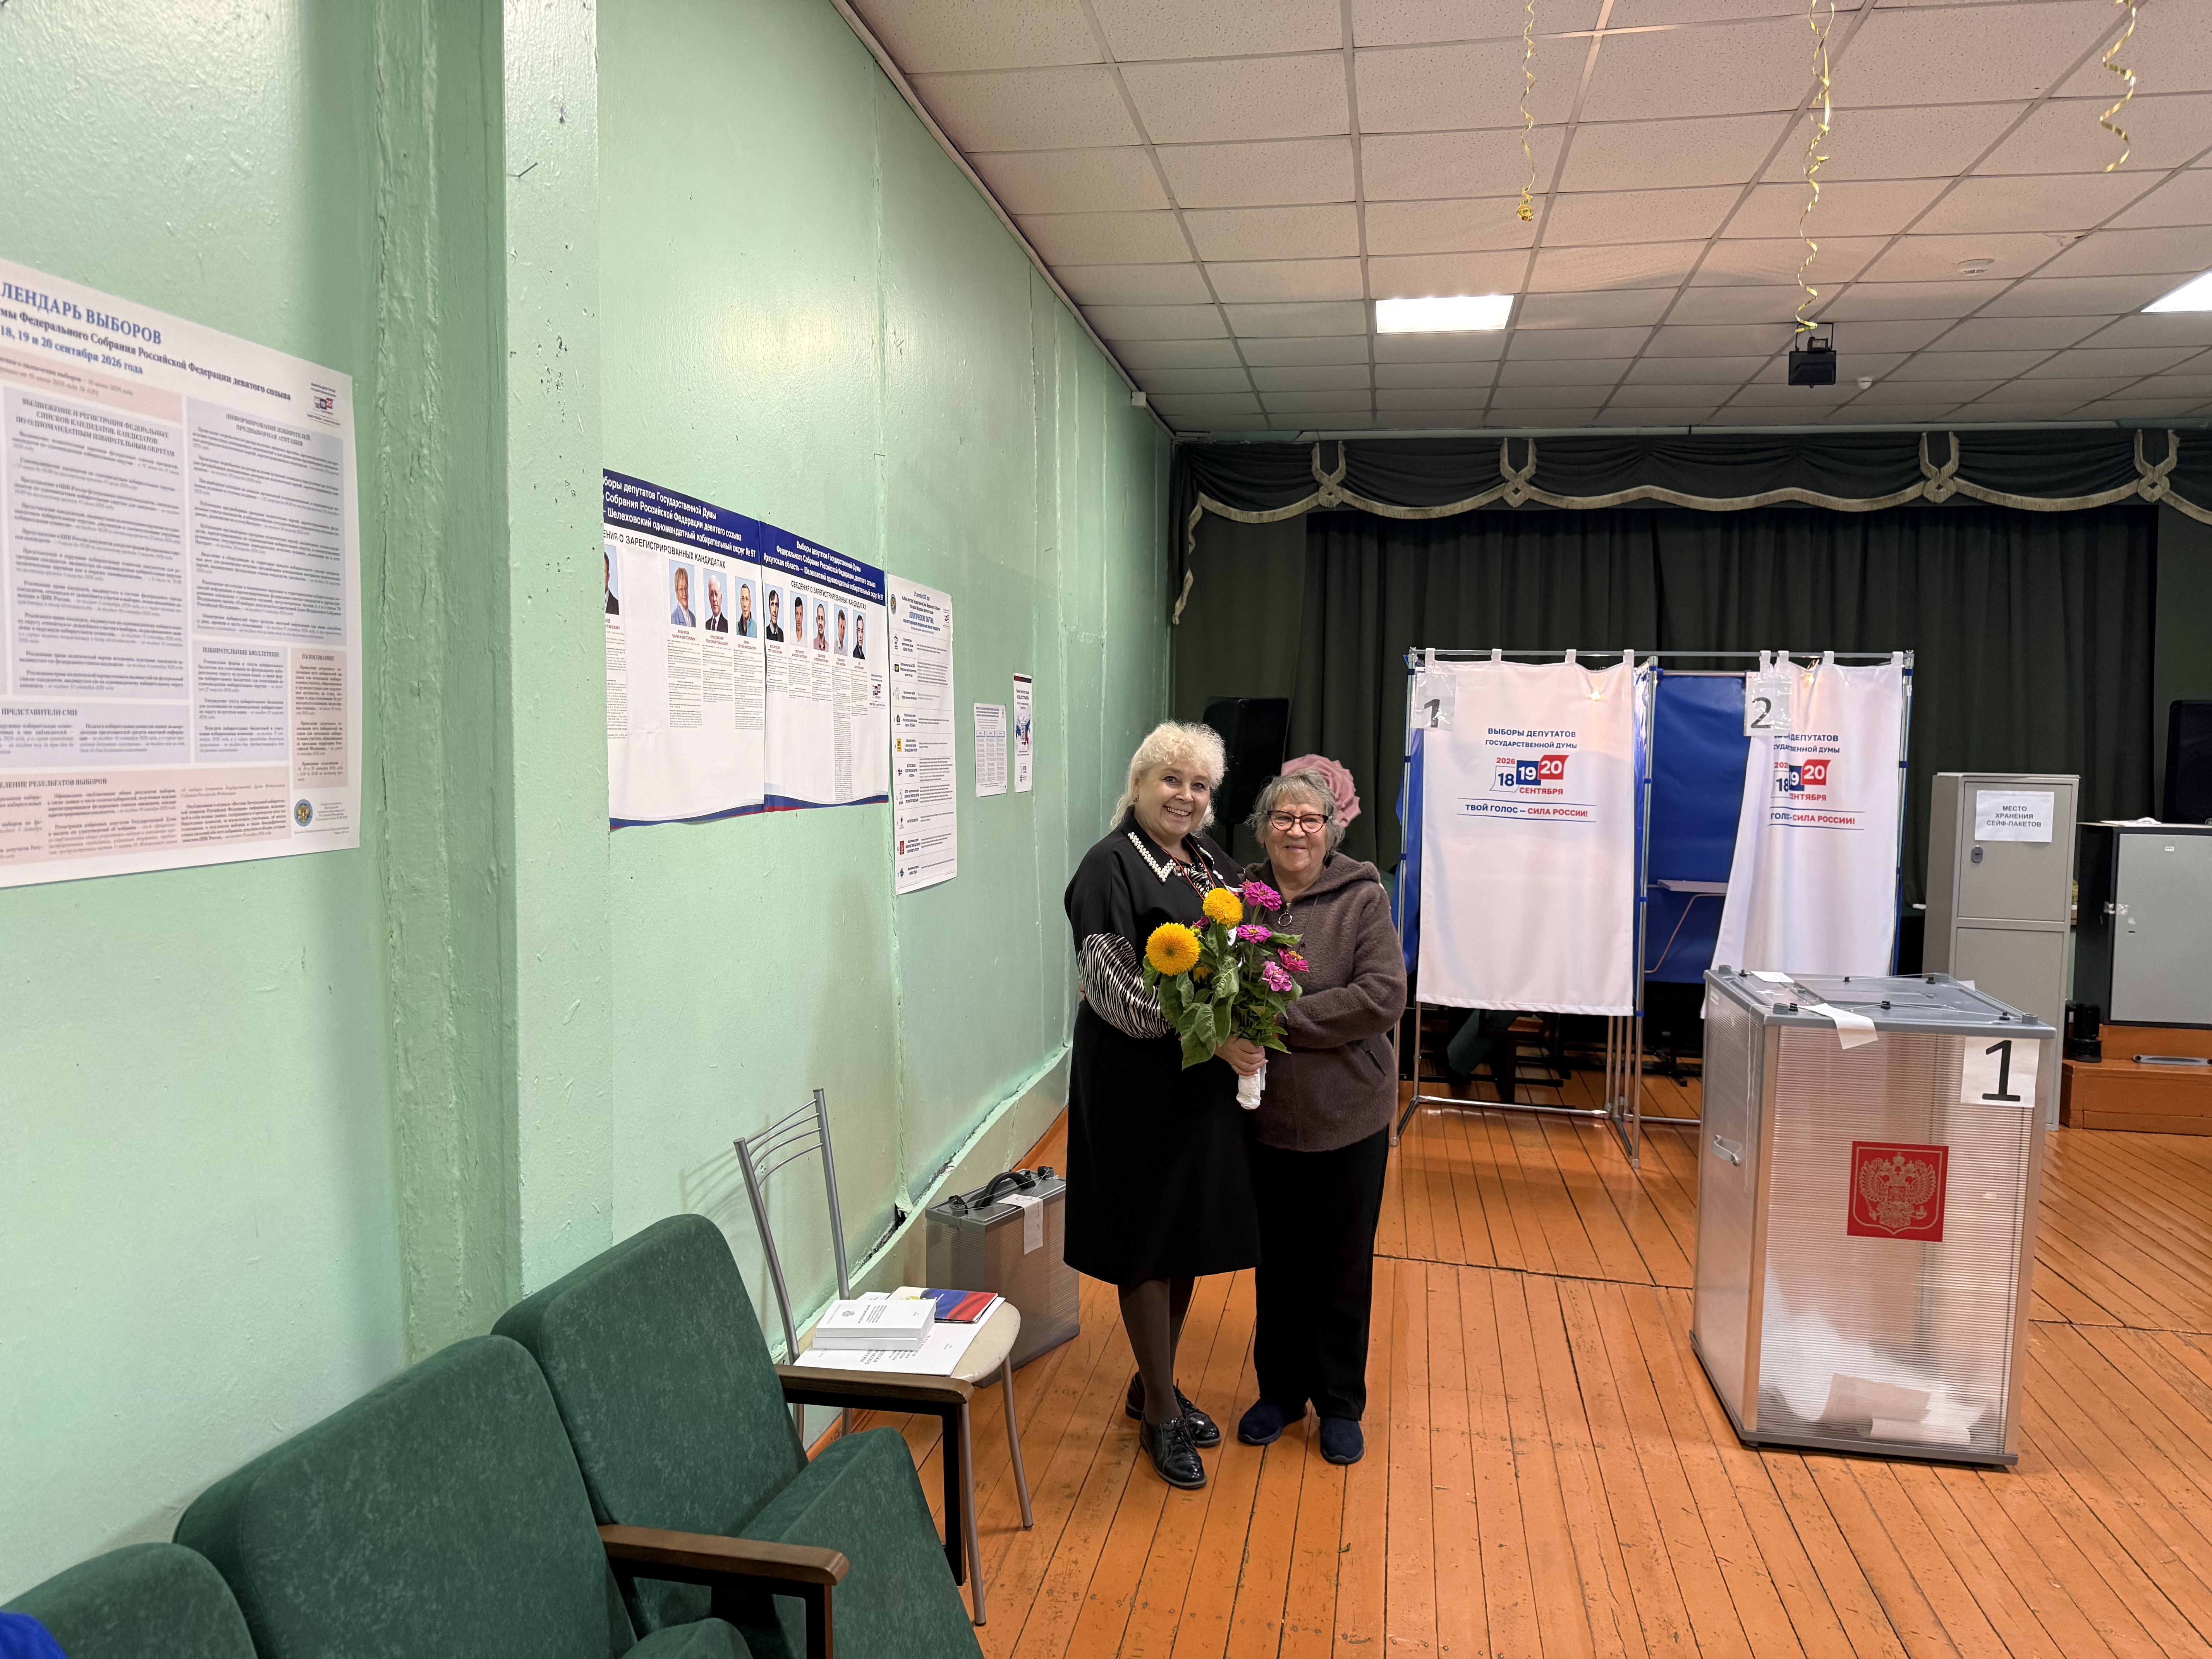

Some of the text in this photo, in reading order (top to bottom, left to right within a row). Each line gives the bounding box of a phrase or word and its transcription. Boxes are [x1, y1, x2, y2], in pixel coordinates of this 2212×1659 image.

[1, 282, 161, 345] ЛЕНДАРЬ ВЫБОРОВ
[1, 325, 143, 374] 18, 19 и 20 сентября 2026 года
[19, 312, 88, 340] Федерального
[91, 333, 136, 355] Собрания
[138, 347, 187, 370] Российской
[189, 362, 232, 383] Федерации
[233, 378, 265, 393] девятого
[266, 388, 291, 401] созыва
[603, 476, 716, 519] боры депутатов Государственной Думы
[605, 491, 742, 541] Собрания Российской Федерации девятого созыва
[608, 507, 651, 527] Шелеховский
[653, 521, 695, 540] одномандатный
[697, 534, 732, 551] избирательный
[733, 546, 745, 556] округ
[746, 547, 750, 556] №
[751, 549, 756, 558] 97
[620, 534, 623, 542] О
[626, 535, 693, 560] ЗАРЕГИСТРИРОВАННЫХ
[695, 554, 725, 568] КАНДИДАТАХ
[776, 545, 803, 561] Федерального
[803, 555, 819, 567] Собрания
[820, 561, 838, 574] Российской
[838, 568, 854, 580] Федерации
[797, 541, 811, 553] Выборы
[812, 548, 828, 560] депутатов
[828, 553, 853, 569] Государственной
[764, 552, 784, 566] Иркутская
[785, 561, 800, 571] область
[804, 567, 826, 580] Шелеховский
[827, 576, 850, 588] одномандатный
[850, 584, 870, 596] избирательный
[791, 580, 810, 591] СВЕДЕНИЯ
[814, 587, 848, 603] ЗАРЕГИСТРИРОВАННЫХ
[848, 599, 866, 610] КАНДИДАТАХ
[1424, 699, 1440, 728] 1
[1750, 697, 1772, 729] 2
[1486, 740, 1554, 748] ГОСУДАРСТВЕННОЙ
[1488, 728, 1524, 736] ВЫБОРЫ
[1498, 760, 1562, 787] 18 19 20
[1776, 778, 1788, 792] 18
[1803, 765, 1825, 780] 20
[1553, 809, 1588, 817] РОССИИ!
[1818, 816, 1855, 824] РОССИИ!
[1982, 1040, 2021, 1102] 1
